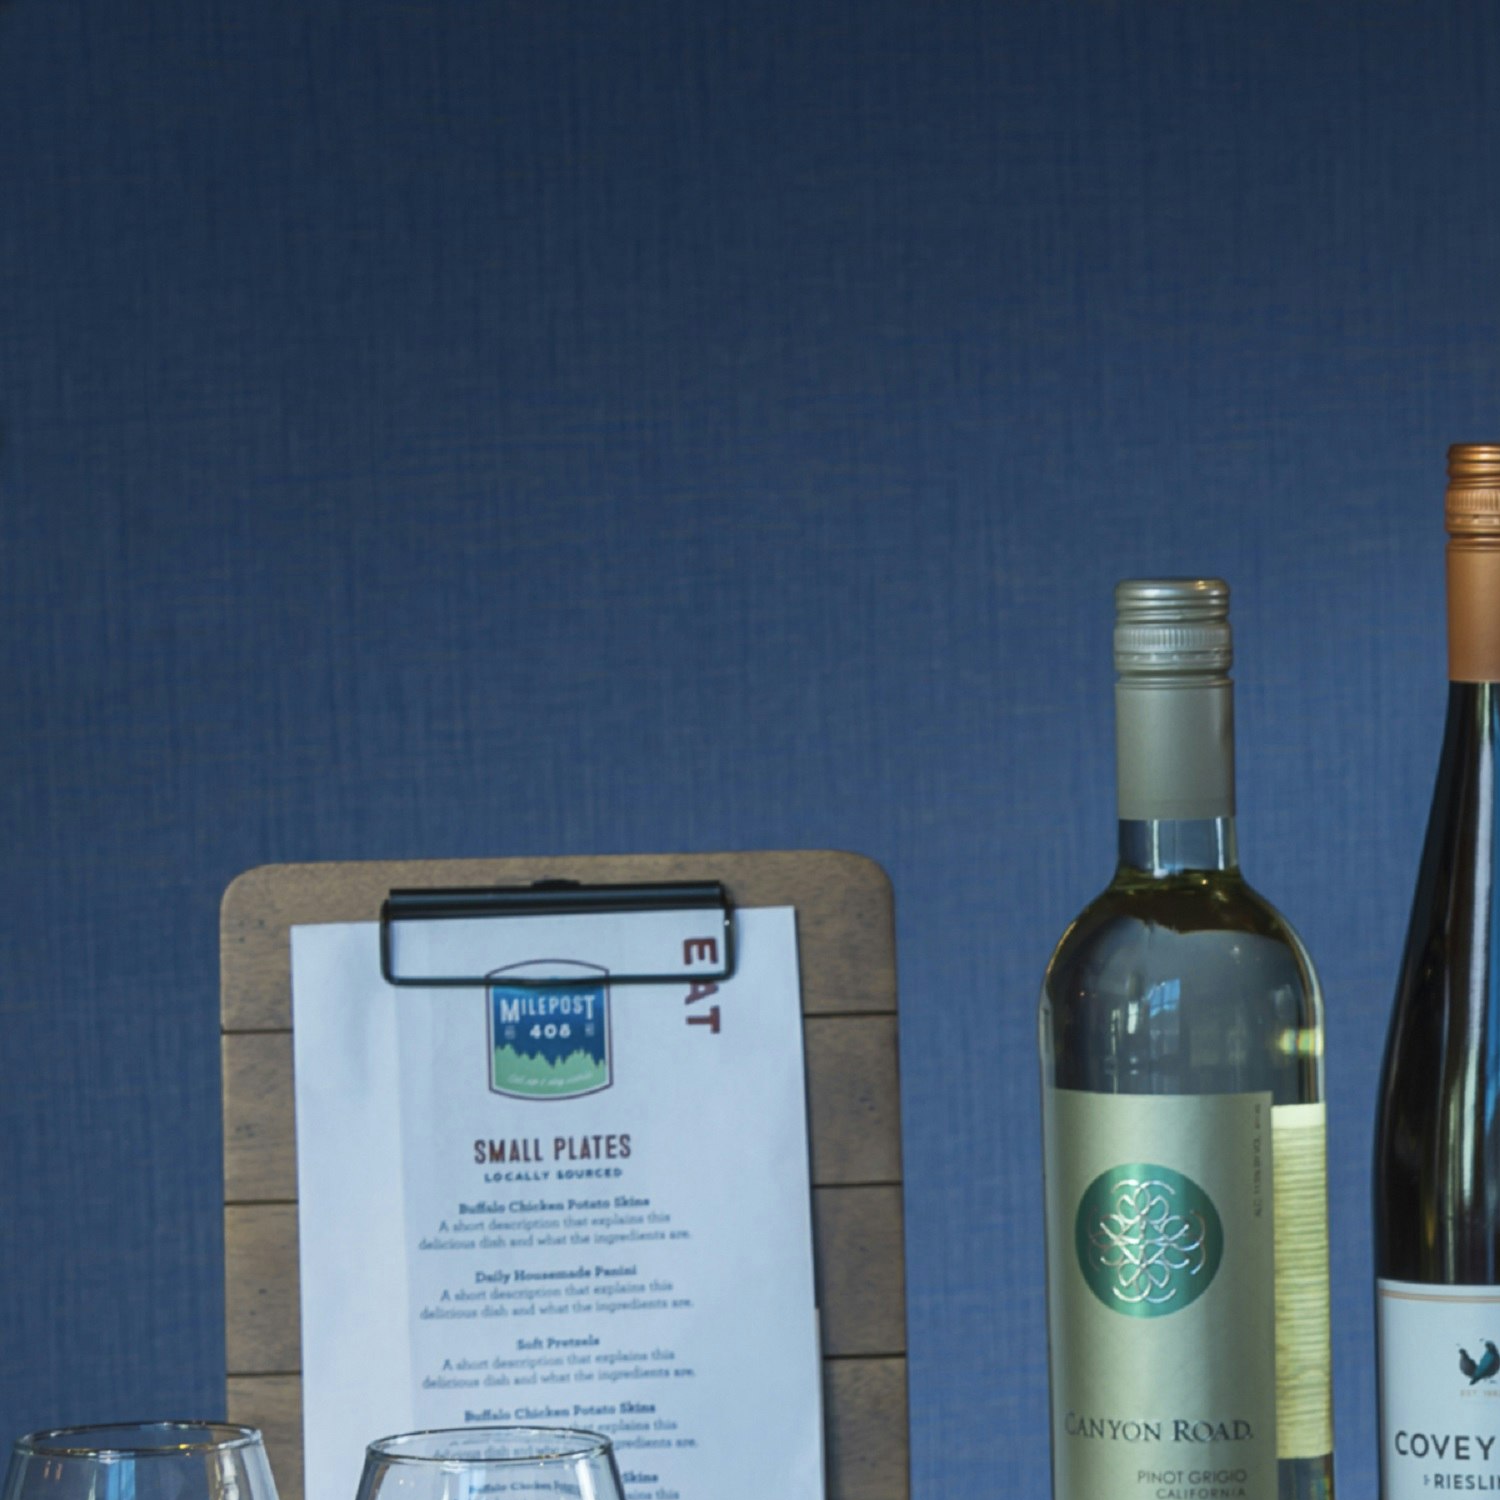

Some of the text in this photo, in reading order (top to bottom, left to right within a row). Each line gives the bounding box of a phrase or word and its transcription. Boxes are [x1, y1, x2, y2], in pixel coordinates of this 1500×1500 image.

[682, 937, 720, 1034] EAT
[501, 994, 595, 1024] MILEPOST
[529, 1023, 572, 1040] 408
[474, 1134, 632, 1165] SMALL PLATES
[484, 1168, 623, 1183] LOCALLY SOURCED
[458, 1195, 650, 1215] Buffalo Chicken Potato Skins
[438, 1211, 670, 1233] A short description that explains this
[419, 1237, 475, 1250] delicious
[479, 1235, 506, 1248] dish
[510, 1235, 533, 1247] and
[537, 1233, 566, 1246] what
[569, 1232, 590, 1245] the
[593, 1230, 666, 1246] ingredients
[475, 1265, 637, 1285] Daily Housemade Panini
[440, 1279, 673, 1302] A short description that explains this
[420, 1306, 477, 1320] delicious
[481, 1304, 508, 1318] dish
[512, 1303, 535, 1316] and
[539, 1301, 569, 1315] what
[572, 1300, 592, 1313] the
[595, 1297, 668, 1314] ingredients
[517, 1335, 600, 1351] Soft Pretzels
[443, 1348, 675, 1371] A short description that explains this
[422, 1376, 479, 1390] delicious
[484, 1374, 510, 1387] dish
[514, 1373, 537, 1385] and
[541, 1371, 570, 1384] what
[574, 1369, 594, 1382] the
[597, 1367, 670, 1384] ingredients
[464, 1401, 656, 1422] Buffalo Chicken Potato Skins
[1064, 1411, 1161, 1442] CANYON
[613, 1436, 672, 1451] gredients
[1395, 1430, 1496, 1461] COVEY
[1137, 1469, 1248, 1485] PINOT GRIGIO
[1156, 1487, 1248, 1500] CALIFORNIA
